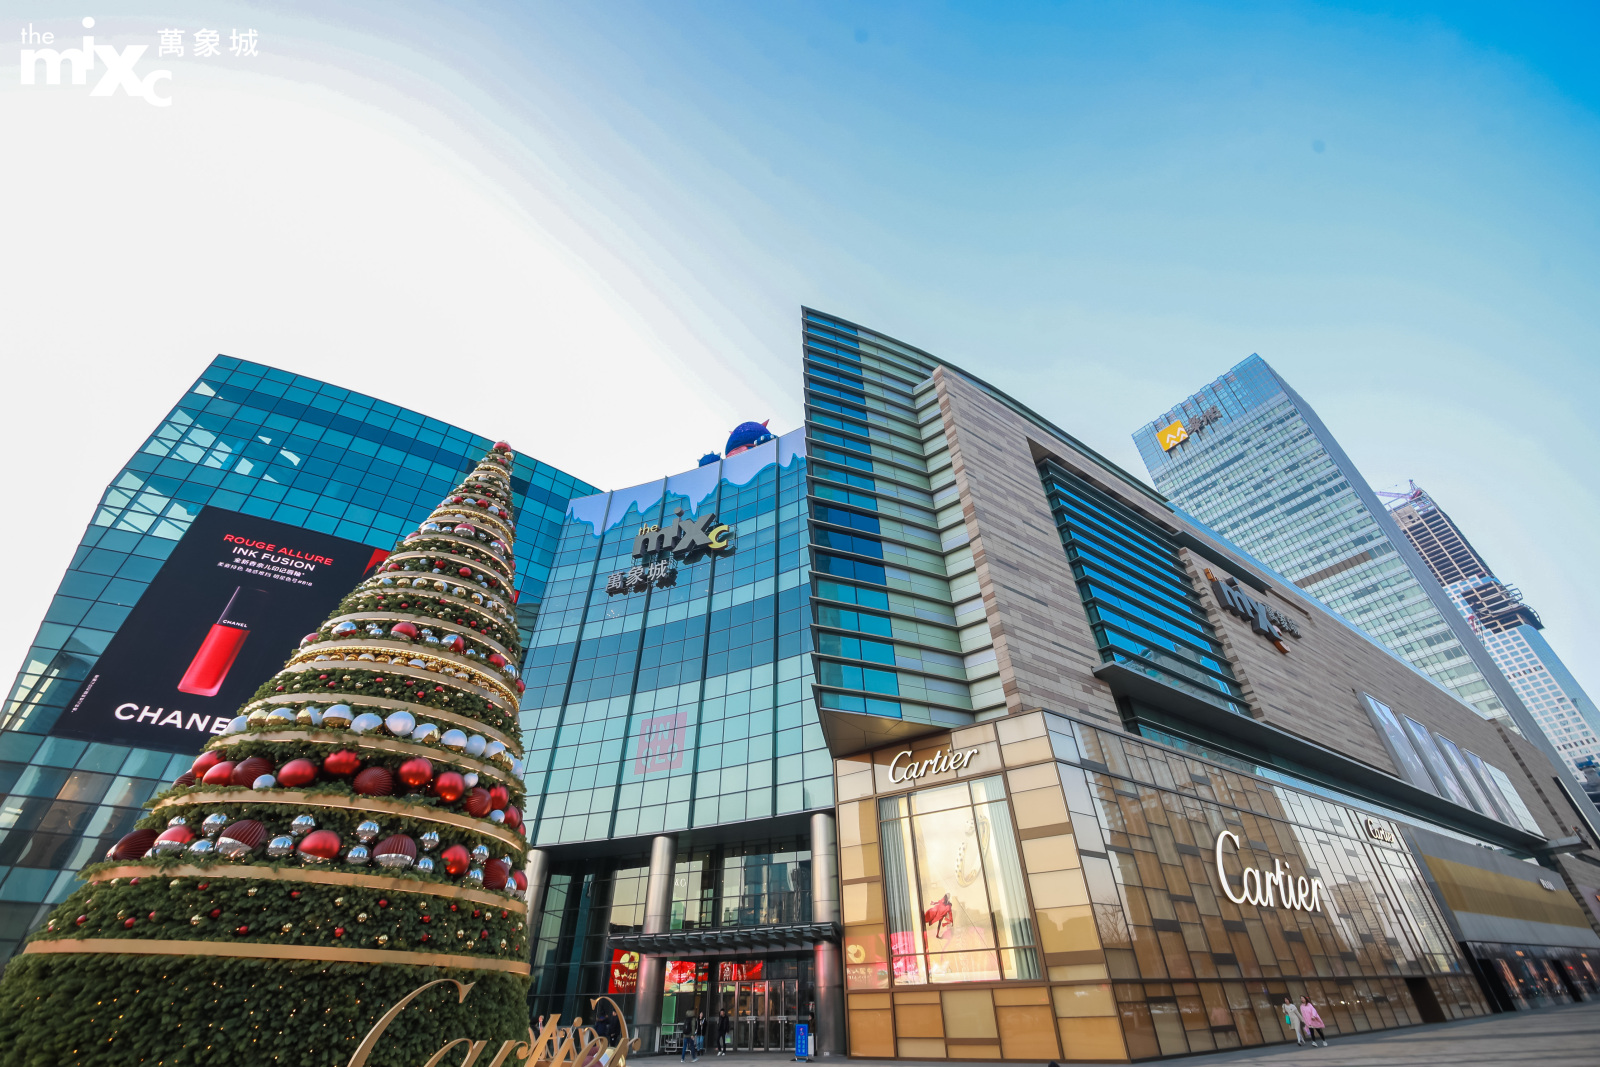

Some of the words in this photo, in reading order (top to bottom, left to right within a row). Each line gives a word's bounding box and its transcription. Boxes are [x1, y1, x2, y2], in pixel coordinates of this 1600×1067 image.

[638, 523, 660, 536] the
[223, 534, 276, 552] ROUGE
[277, 547, 334, 566] ALLURE
[232, 546, 259, 559] INK
[261, 553, 315, 571] FUSION
[607, 559, 669, 591] 萬象城
[222, 619, 248, 628] CHANEL
[114, 702, 232, 736] CHANE
[641, 743, 678, 769] QLO
[888, 748, 979, 784] Cartier
[1366, 818, 1395, 843] Cartier
[1216, 830, 1322, 912] Cartier
